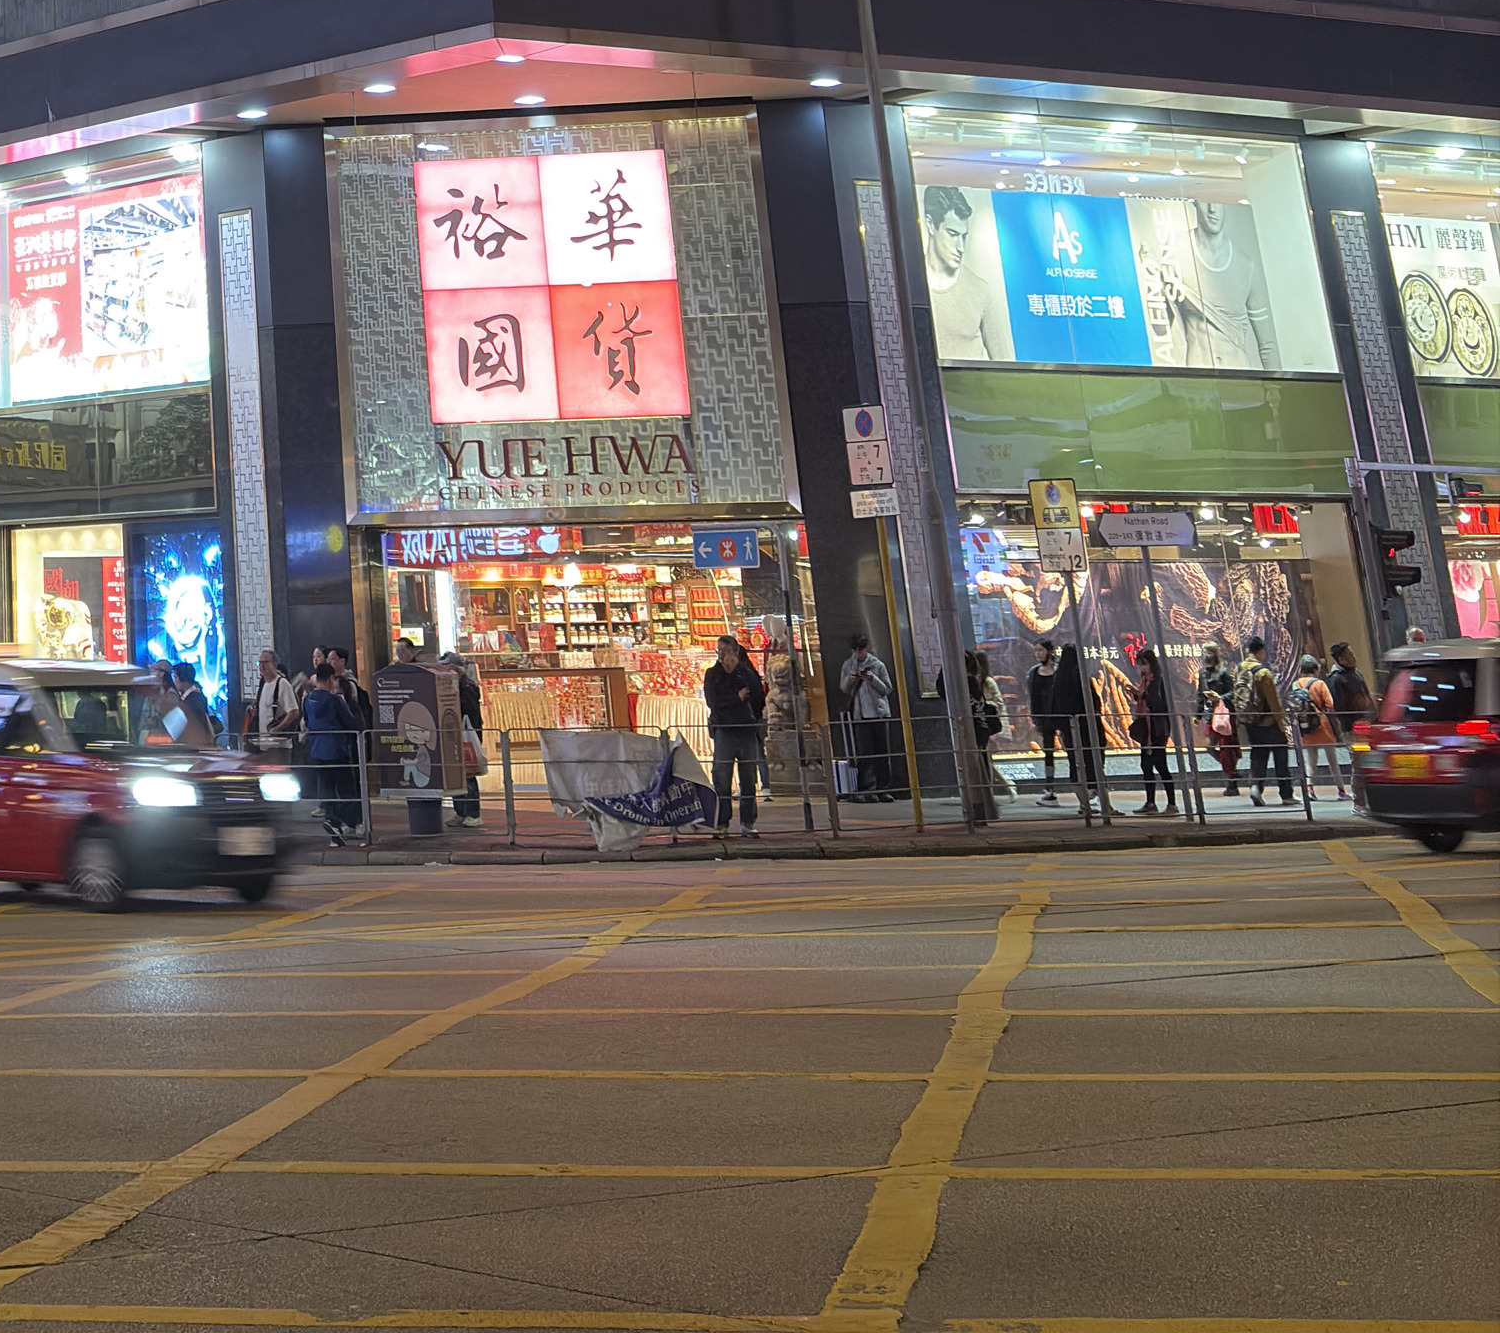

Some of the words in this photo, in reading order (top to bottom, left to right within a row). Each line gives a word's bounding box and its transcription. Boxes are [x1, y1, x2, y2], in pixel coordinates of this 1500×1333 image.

[1027, 294, 1126, 318] 專櫃設於二樓
[436, 437, 549, 480] YUE
[561, 434, 698, 475] HWA
[873, 445, 880, 458] 7
[876, 467, 883, 481] 7
[438, 483, 552, 501] CHINESE
[565, 479, 701, 497] PRODUCTS
[1124, 517, 1150, 525] Nathan
[1151, 516, 1169, 525] Road
[1064, 532, 1071, 545] 7
[1069, 555, 1082, 570] 12
[613, 800, 651, 825] Drone
[653, 817, 664, 826] in
